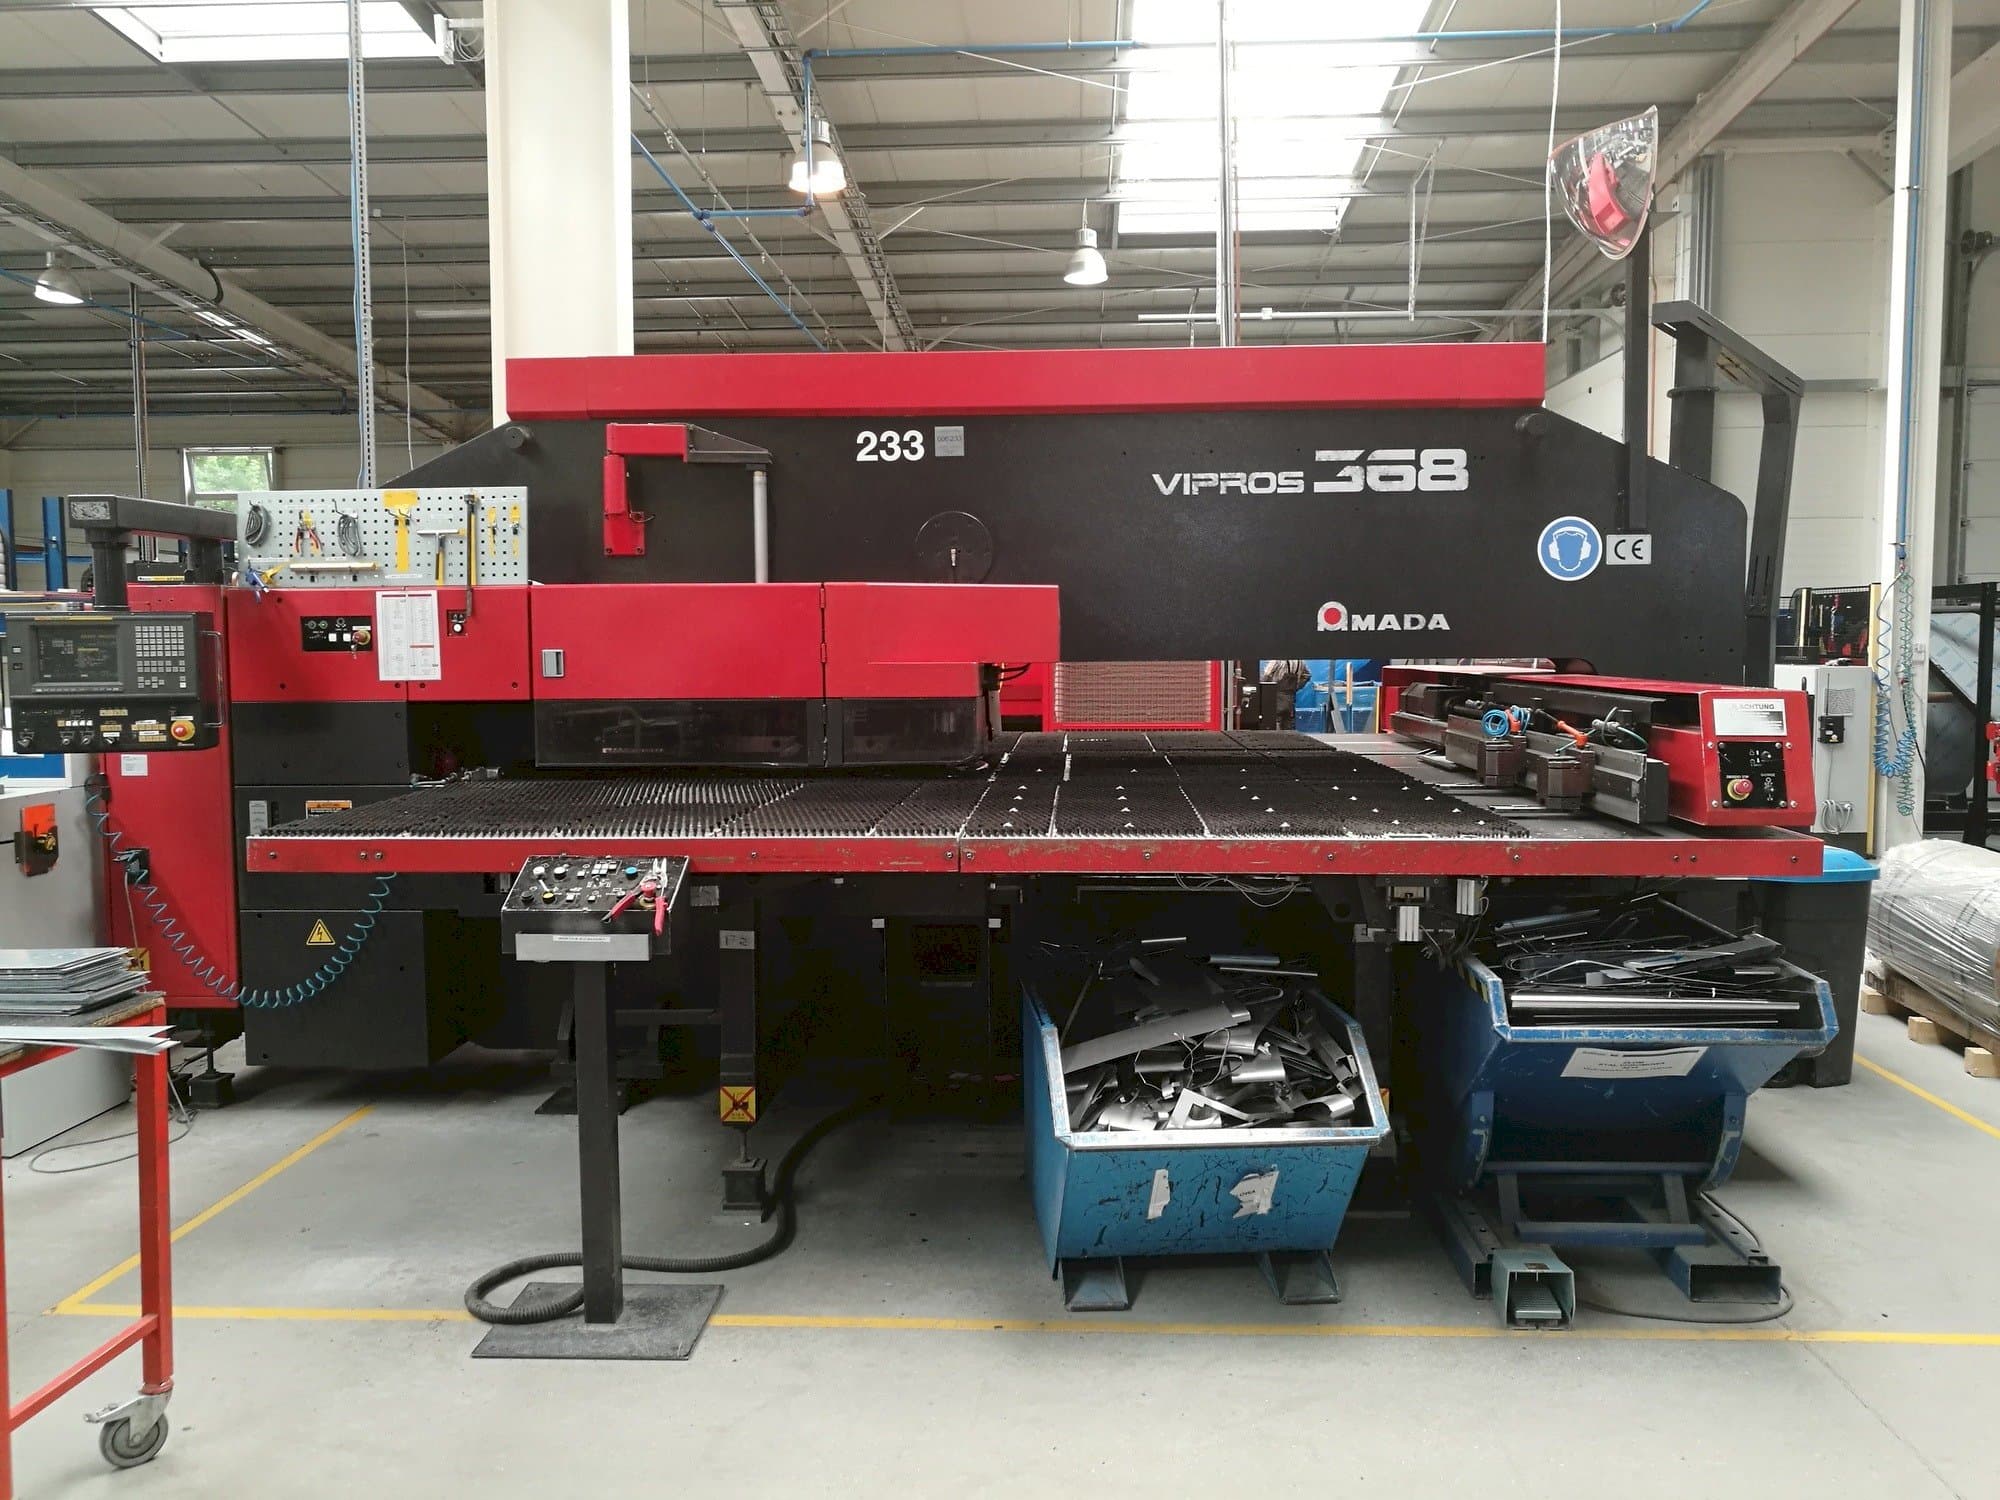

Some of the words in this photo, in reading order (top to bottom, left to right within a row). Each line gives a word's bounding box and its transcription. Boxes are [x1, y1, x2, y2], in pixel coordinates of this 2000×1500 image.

[856, 430, 925, 462] 233
[1152, 471, 1305, 496] VIPROS
[1313, 449, 1469, 493] 368
[1614, 539, 1643, 560] CE
[1317, 601, 1450, 631] AMADA
